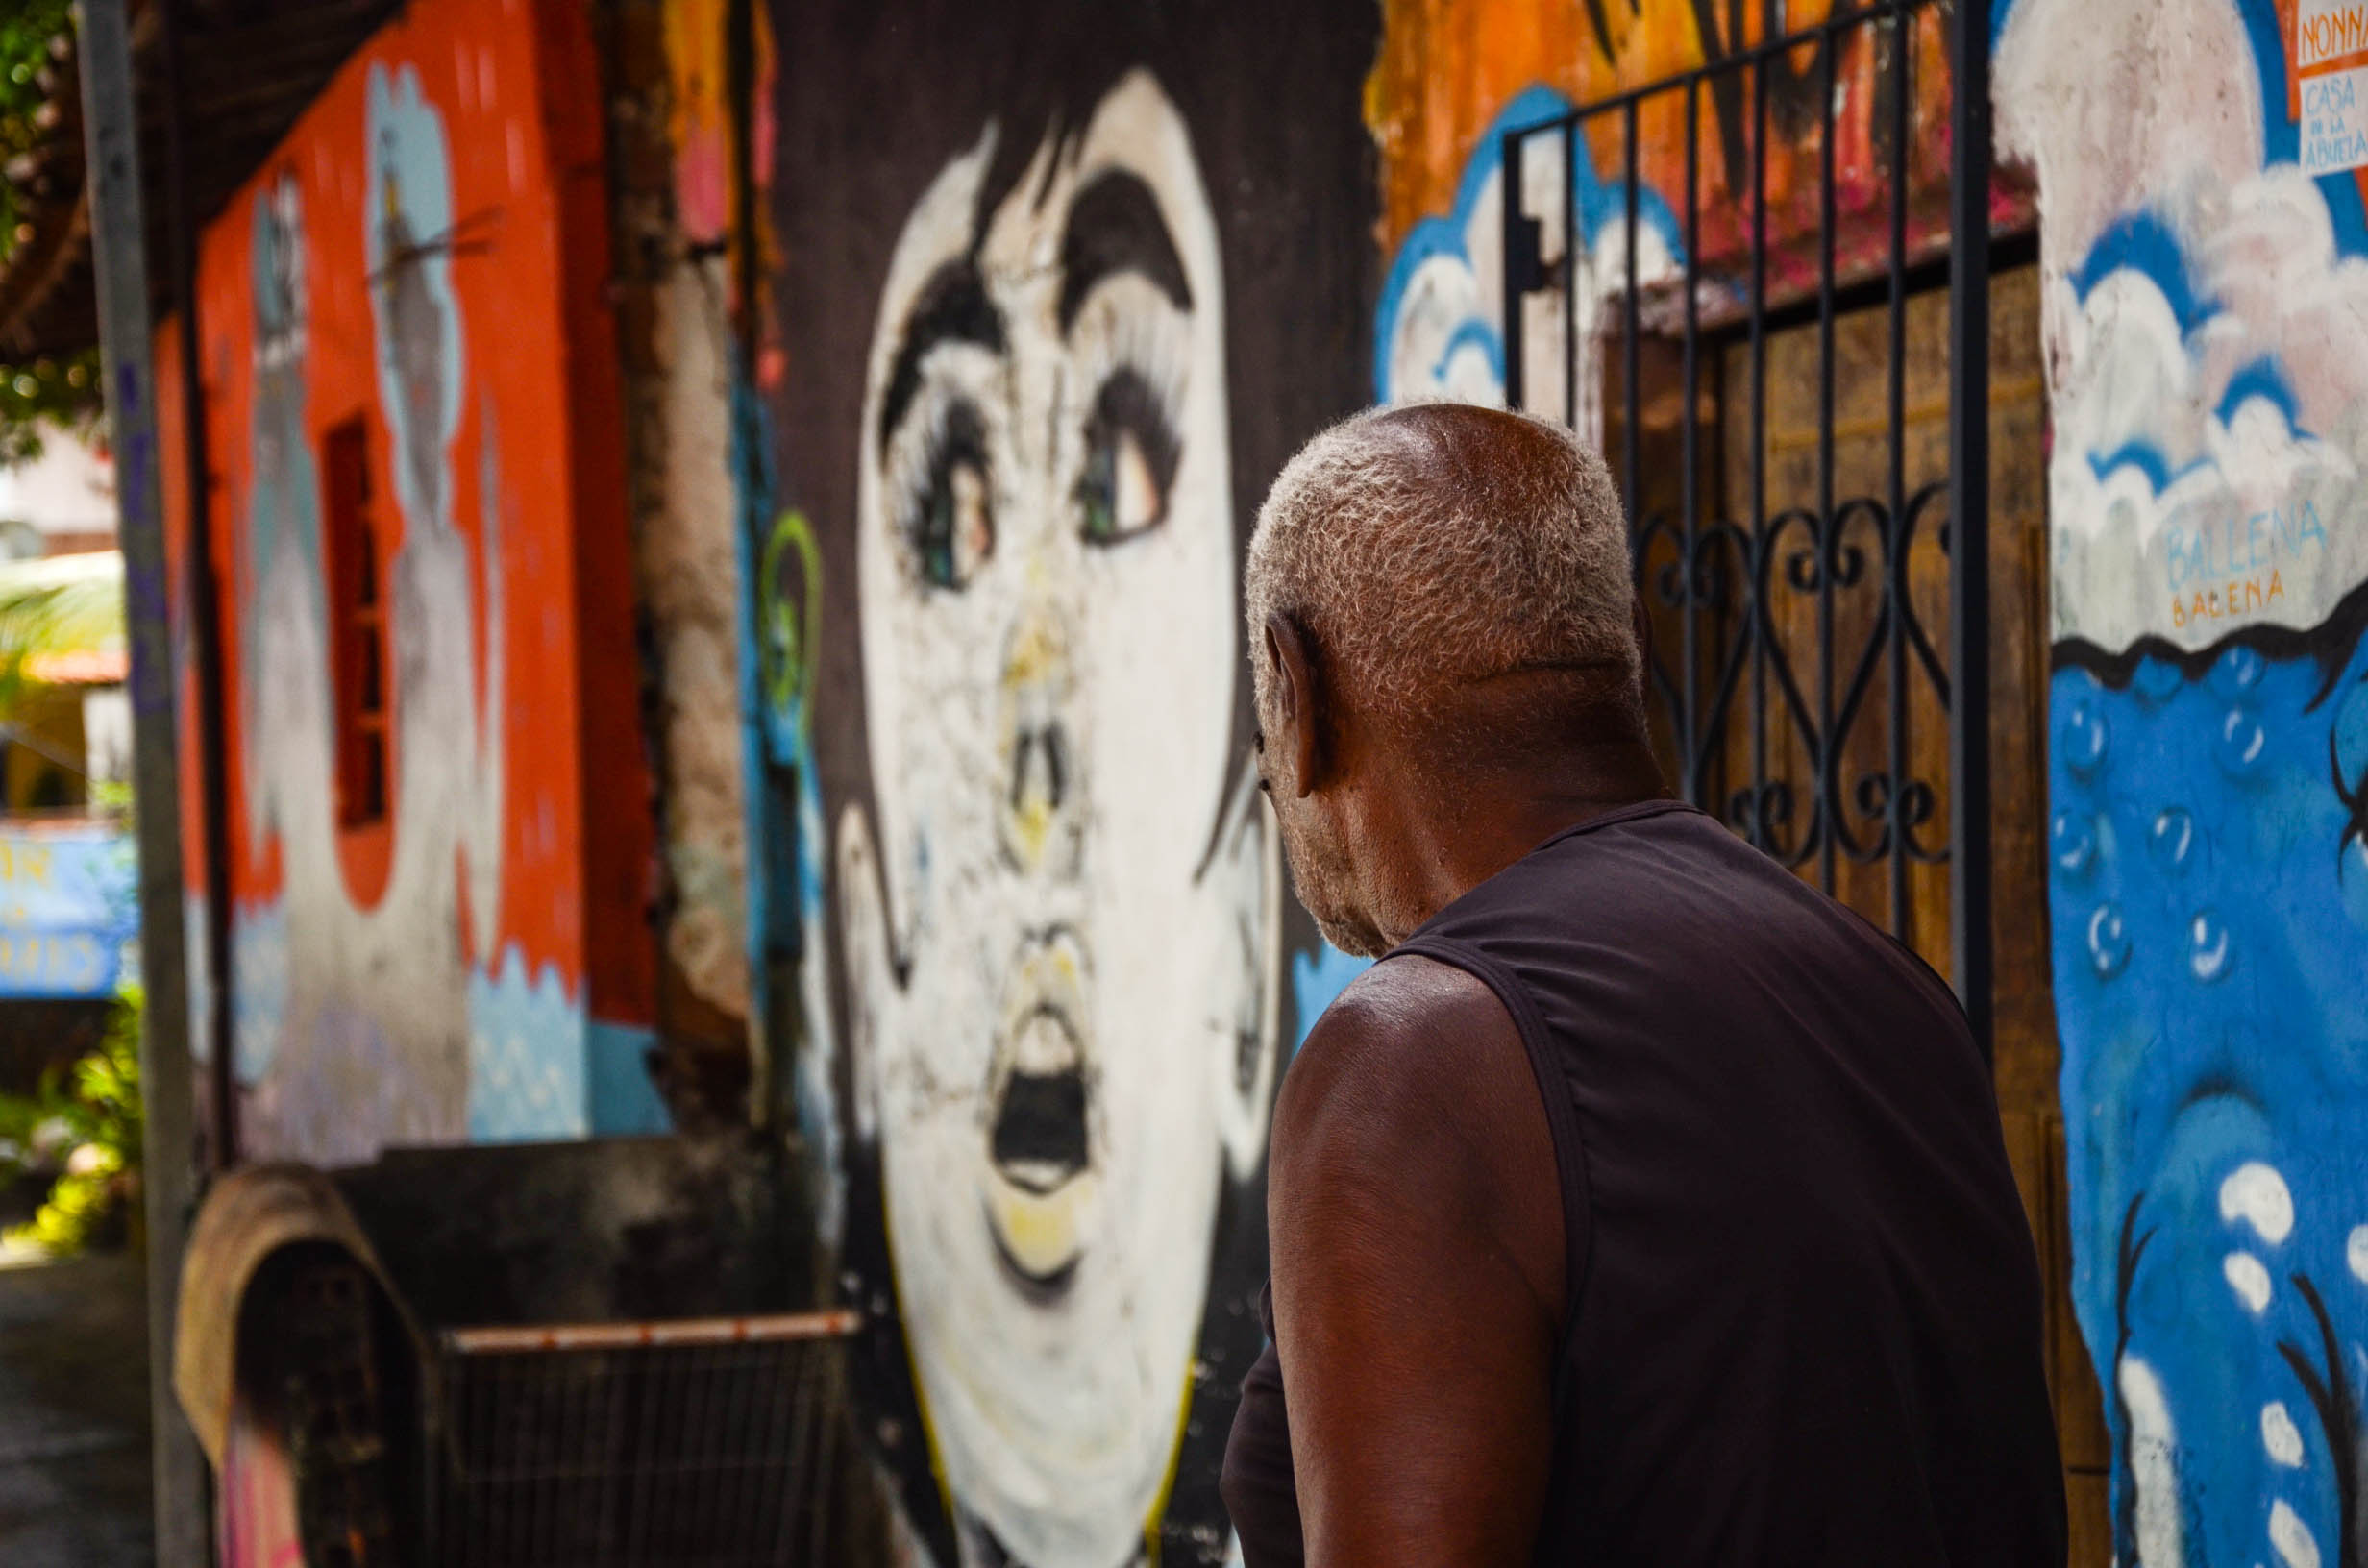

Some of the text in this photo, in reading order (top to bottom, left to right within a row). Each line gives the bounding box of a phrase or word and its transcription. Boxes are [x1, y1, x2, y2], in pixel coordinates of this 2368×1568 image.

[2306, 74, 2356, 115] CASA
[2167, 499, 2328, 593] BALLENA
[2172, 568, 2285, 629] BALENA
